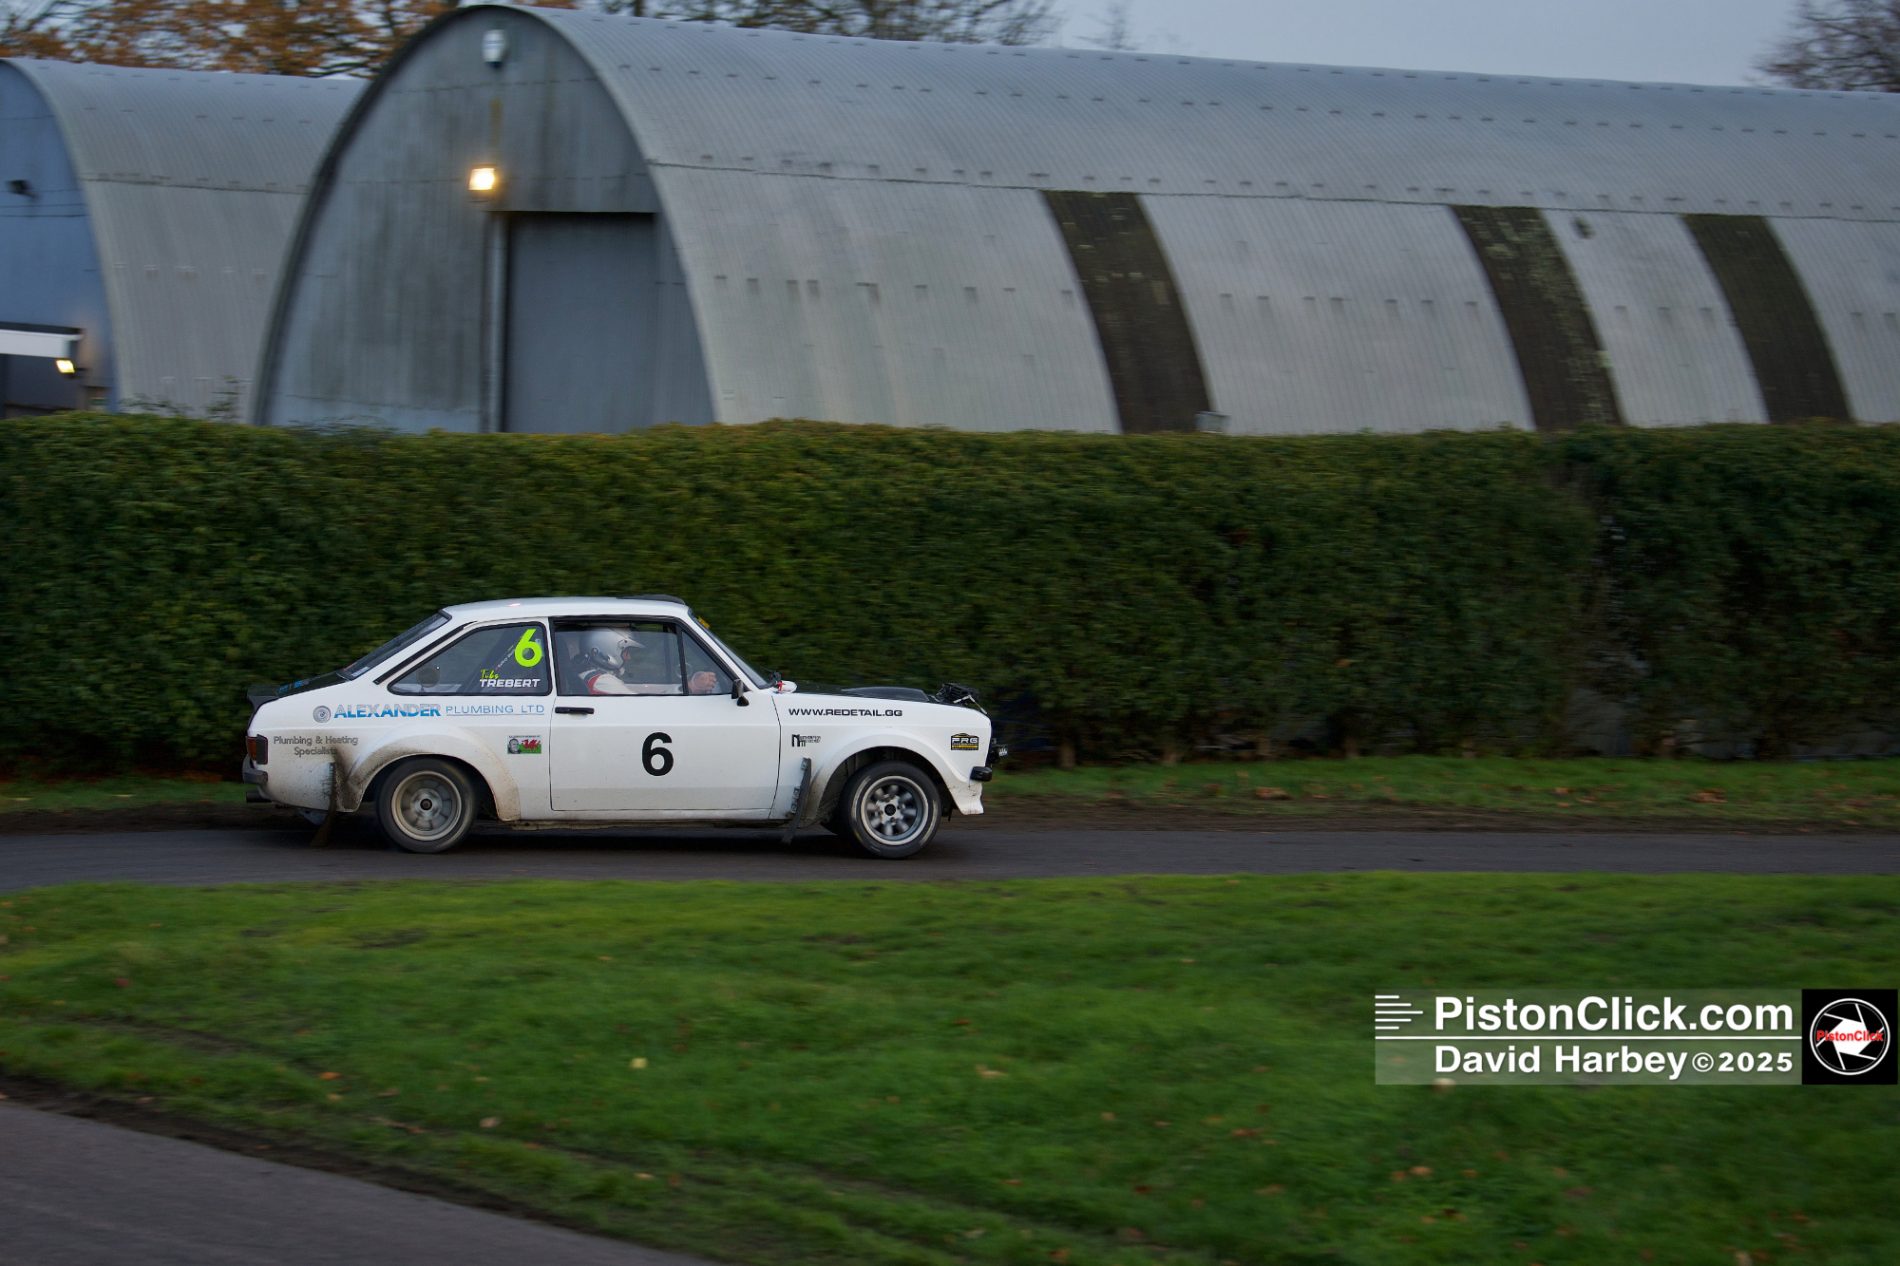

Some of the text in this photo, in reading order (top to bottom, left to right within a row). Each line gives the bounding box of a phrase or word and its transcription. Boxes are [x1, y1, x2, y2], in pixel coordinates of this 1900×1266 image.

[514, 628, 543, 667] 6
[480, 679, 541, 688] TREBERT
[334, 703, 441, 718] ALEXANDER
[446, 704, 514, 714] PLUMBING
[521, 704, 545, 713] LTD
[788, 708, 903, 717] WWW.REDETAIL.GG
[273, 736, 359, 746] Plumbing & Heating
[642, 732, 674, 776] 6
